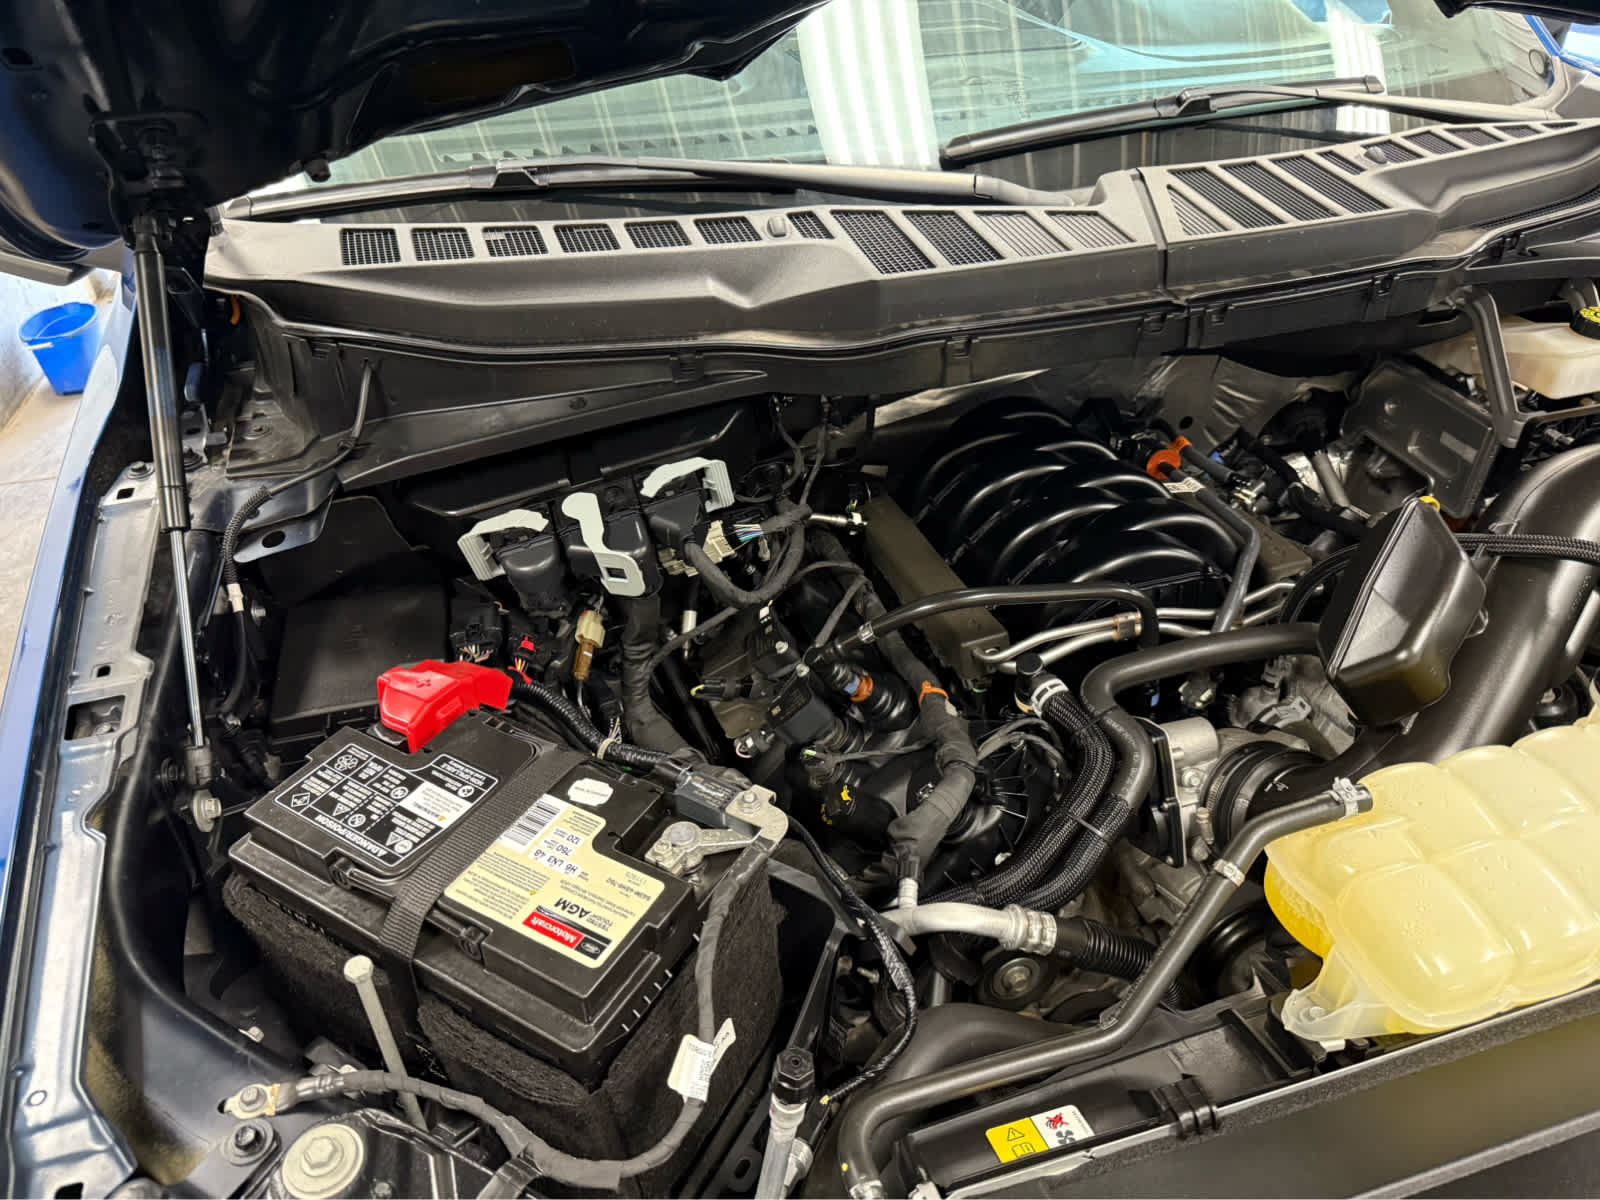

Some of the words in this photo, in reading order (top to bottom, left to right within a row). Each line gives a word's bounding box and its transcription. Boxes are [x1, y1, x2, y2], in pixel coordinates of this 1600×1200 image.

[439, 762, 484, 786] NON-SPILLABLE
[312, 814, 380, 853] DANGER/POISON
[565, 833, 581, 844] 120
[532, 848, 546, 858] 48
[554, 843, 572, 855] 760
[546, 854, 564, 867] LN3
[563, 862, 578, 873] H6
[552, 897, 591, 918] AGM
[529, 916, 577, 943] Motorcraft
